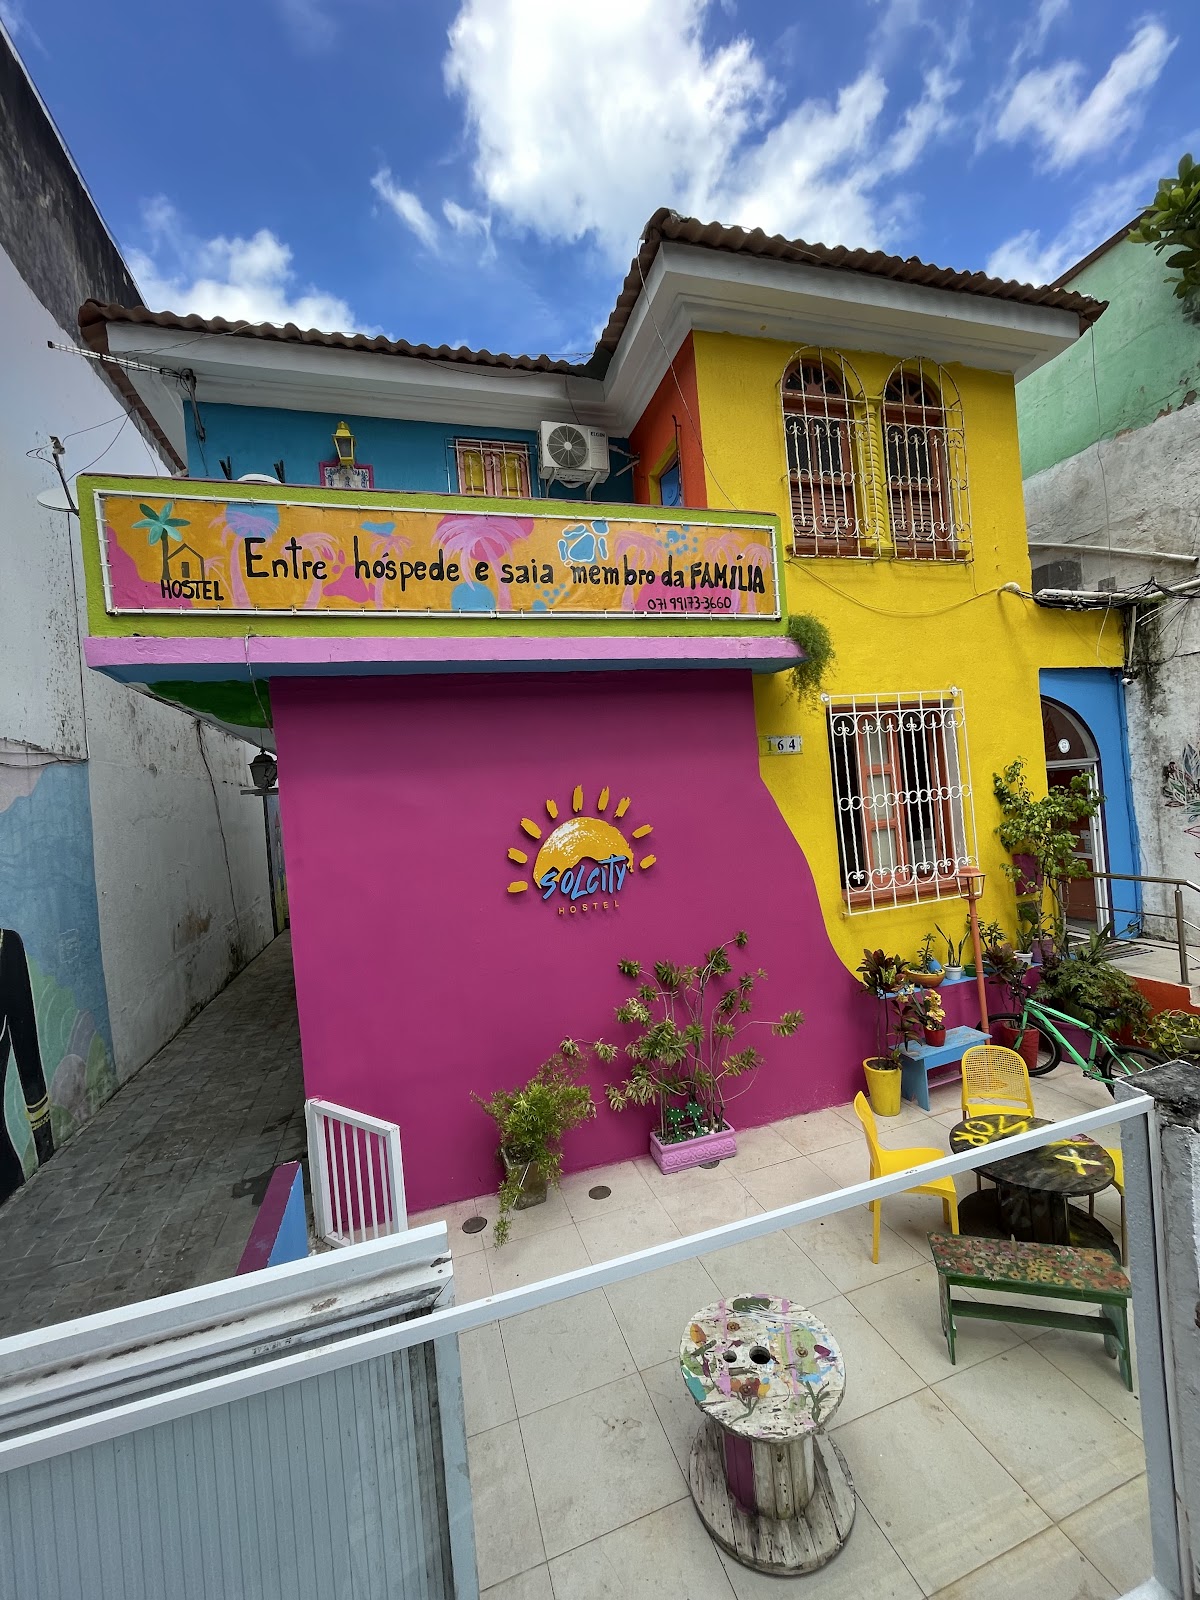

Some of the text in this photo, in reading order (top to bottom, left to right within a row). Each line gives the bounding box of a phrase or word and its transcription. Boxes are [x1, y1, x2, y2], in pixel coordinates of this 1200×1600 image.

[244, 535, 766, 594] Entre hóspede e saia membro da FAMÍLIA
[160, 578, 225, 602] HOSTEL
[647, 595, 732, 611] 071 99173-3660
[767, 738, 796, 752] 164
[540, 854, 629, 901] SOLCITY
[557, 900, 620, 915] HOSTEL
